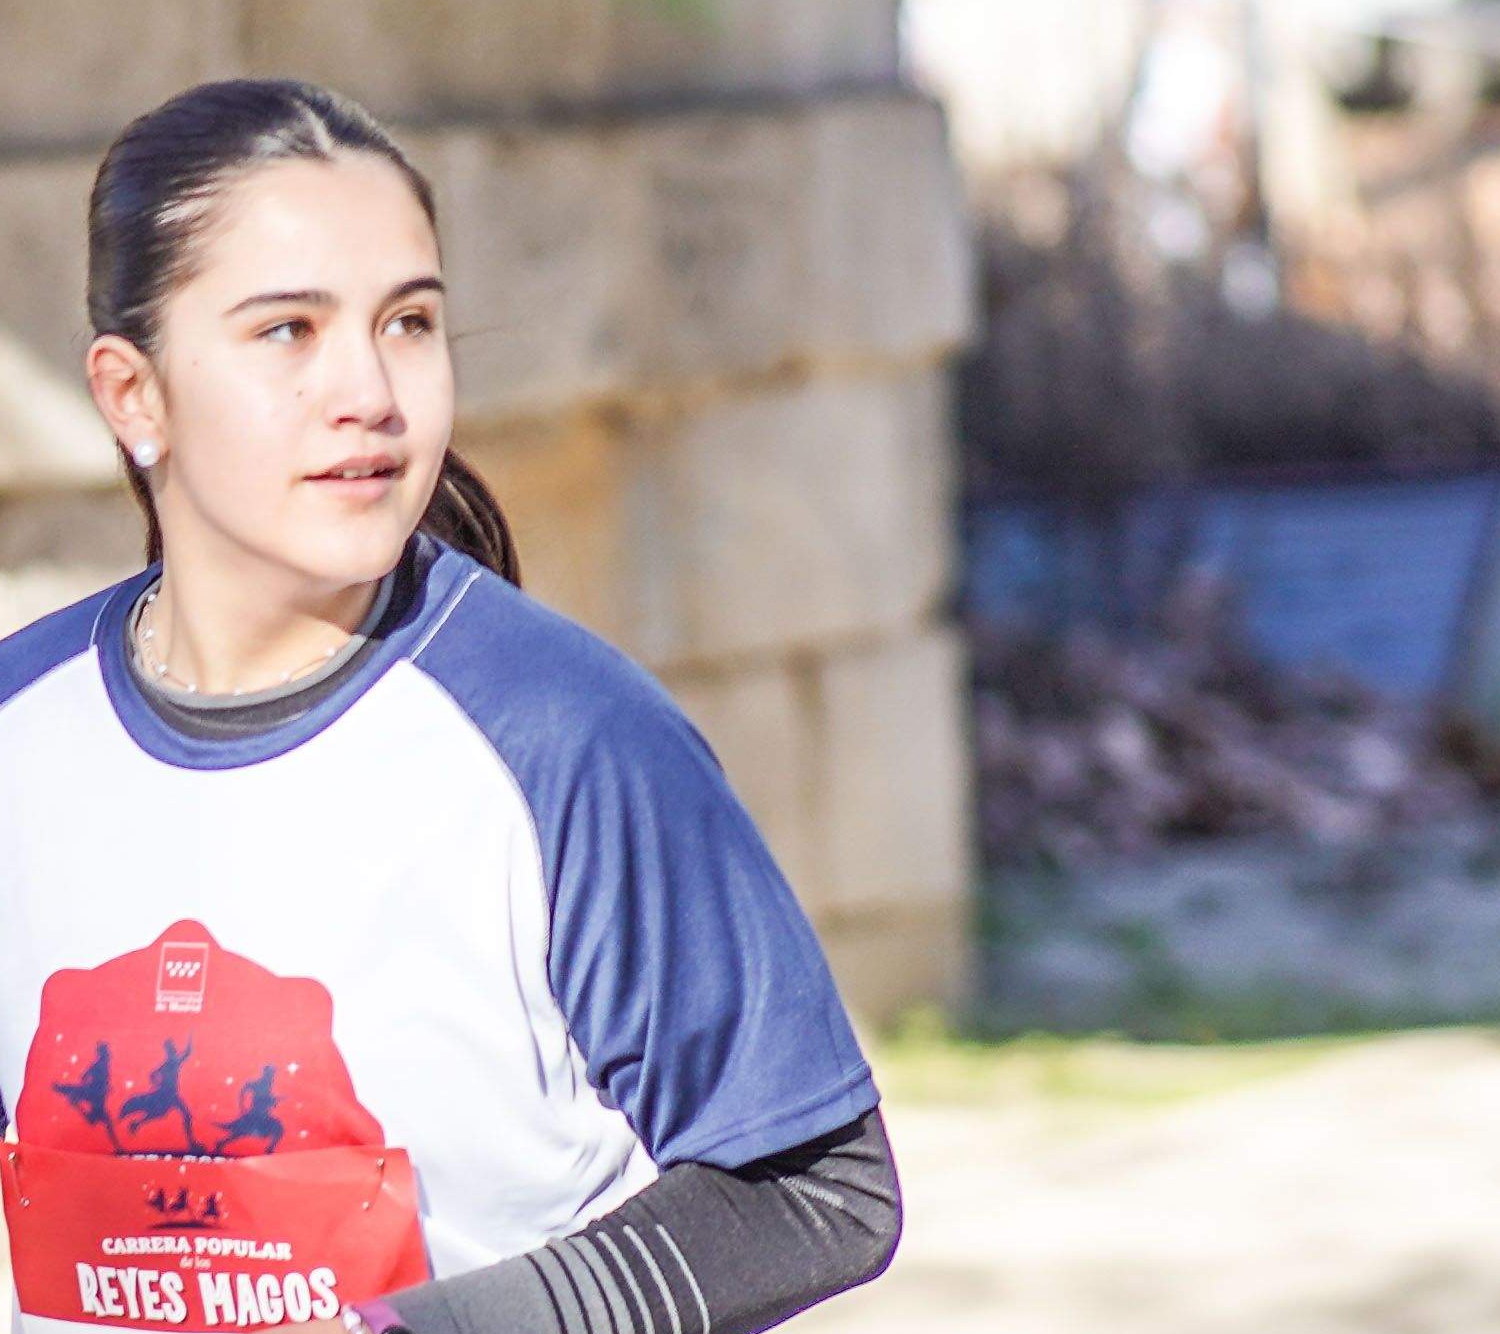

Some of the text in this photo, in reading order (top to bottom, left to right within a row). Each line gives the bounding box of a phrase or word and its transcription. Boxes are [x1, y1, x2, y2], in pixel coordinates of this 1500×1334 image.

[101, 1236, 293, 1261] CARRERA POPULAR
[75, 1261, 341, 1327] REYES MAGOS
